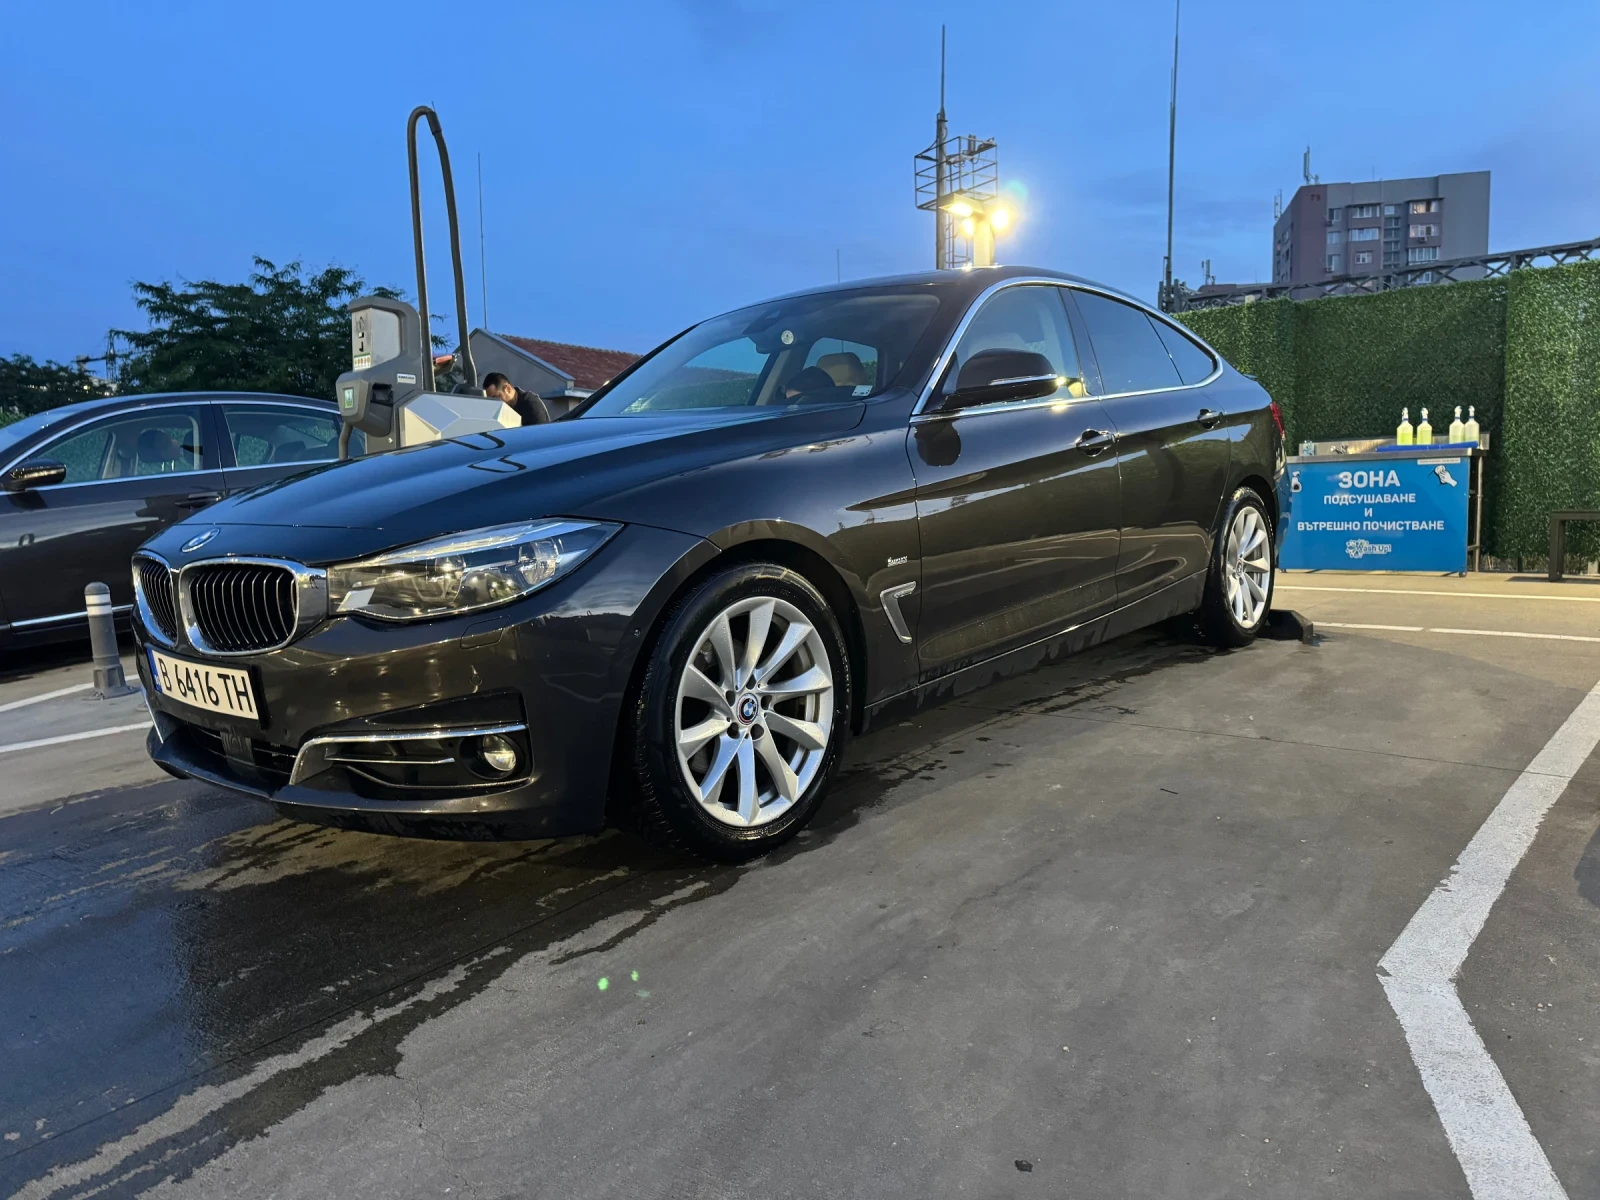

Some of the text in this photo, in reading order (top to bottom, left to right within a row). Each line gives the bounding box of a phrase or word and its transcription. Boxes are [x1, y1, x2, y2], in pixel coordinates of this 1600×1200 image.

[1338, 470, 1400, 488] ЗОНА
[1323, 493, 1417, 506] ПОДСУШАВАНЕ
[1364, 507, 1373, 518] И
[1297, 520, 1444, 532] ВЪТРЕШНО ПОЧИСТВАНЕ
[158, 657, 253, 713] B 6416 TH
